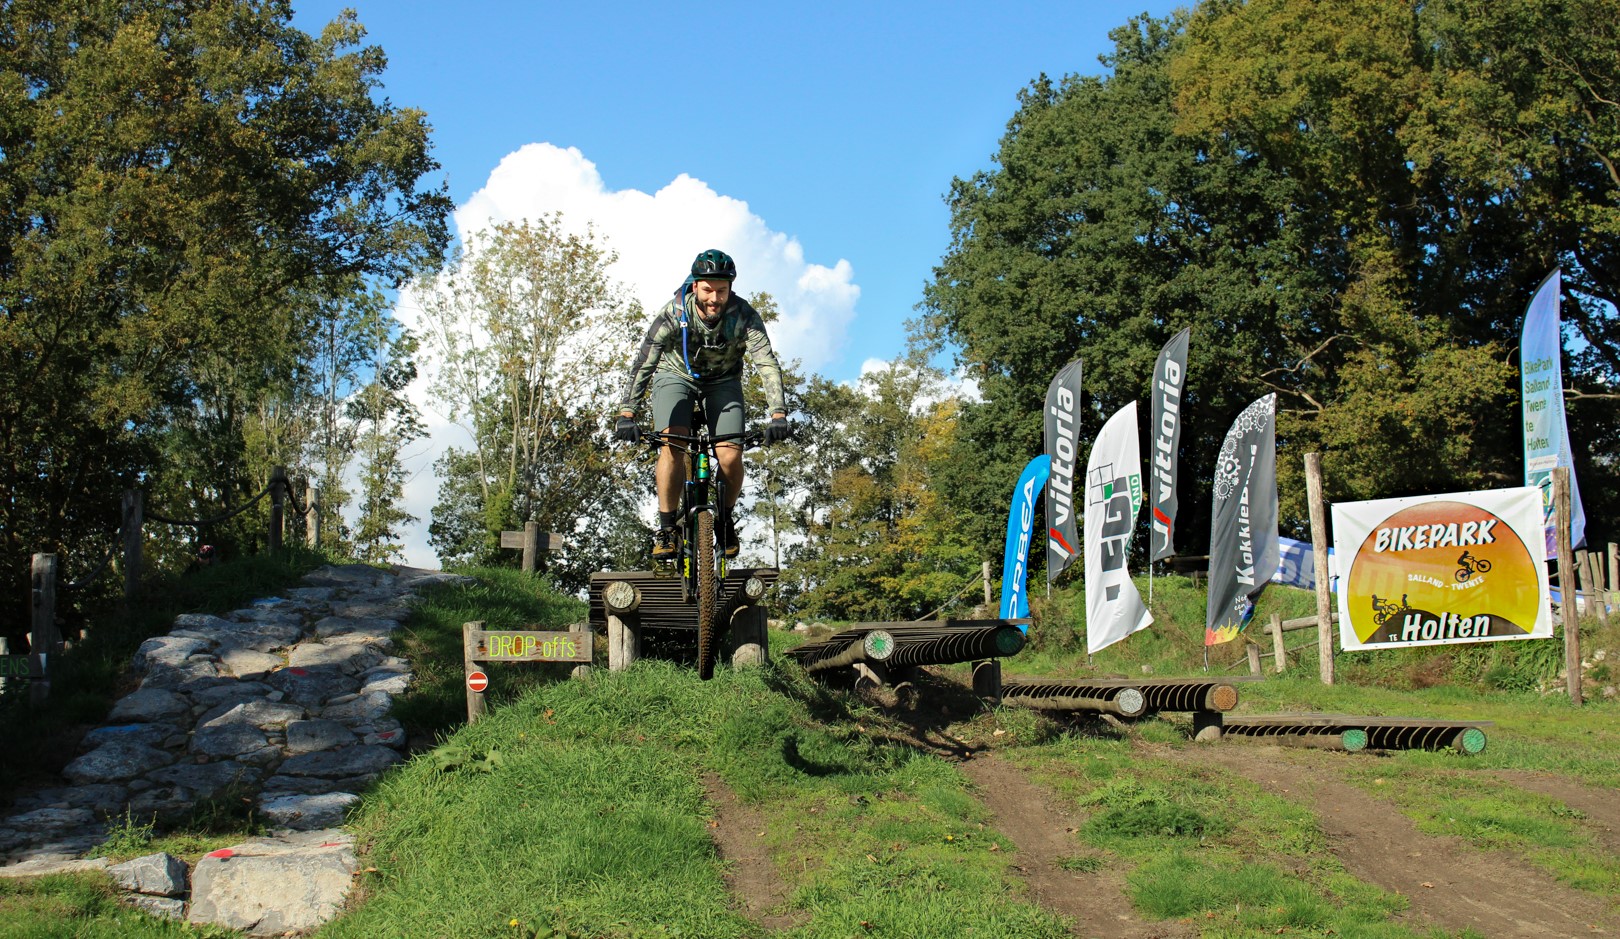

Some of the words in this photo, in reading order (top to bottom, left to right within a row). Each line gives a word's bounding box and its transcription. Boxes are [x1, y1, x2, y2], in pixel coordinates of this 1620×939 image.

[1154, 359, 1180, 503] vittoria
[1526, 420, 1534, 432] te
[1050, 386, 1074, 526] vittoria
[1009, 476, 1036, 619] ORBEA
[1374, 519, 1499, 553] BIKEPARK
[1408, 574, 1443, 588] SALLAND
[1451, 576, 1484, 590] TWENTE
[1402, 612, 1490, 641] Holten
[489, 635, 536, 657] DROP
[543, 636, 576, 658] offs
